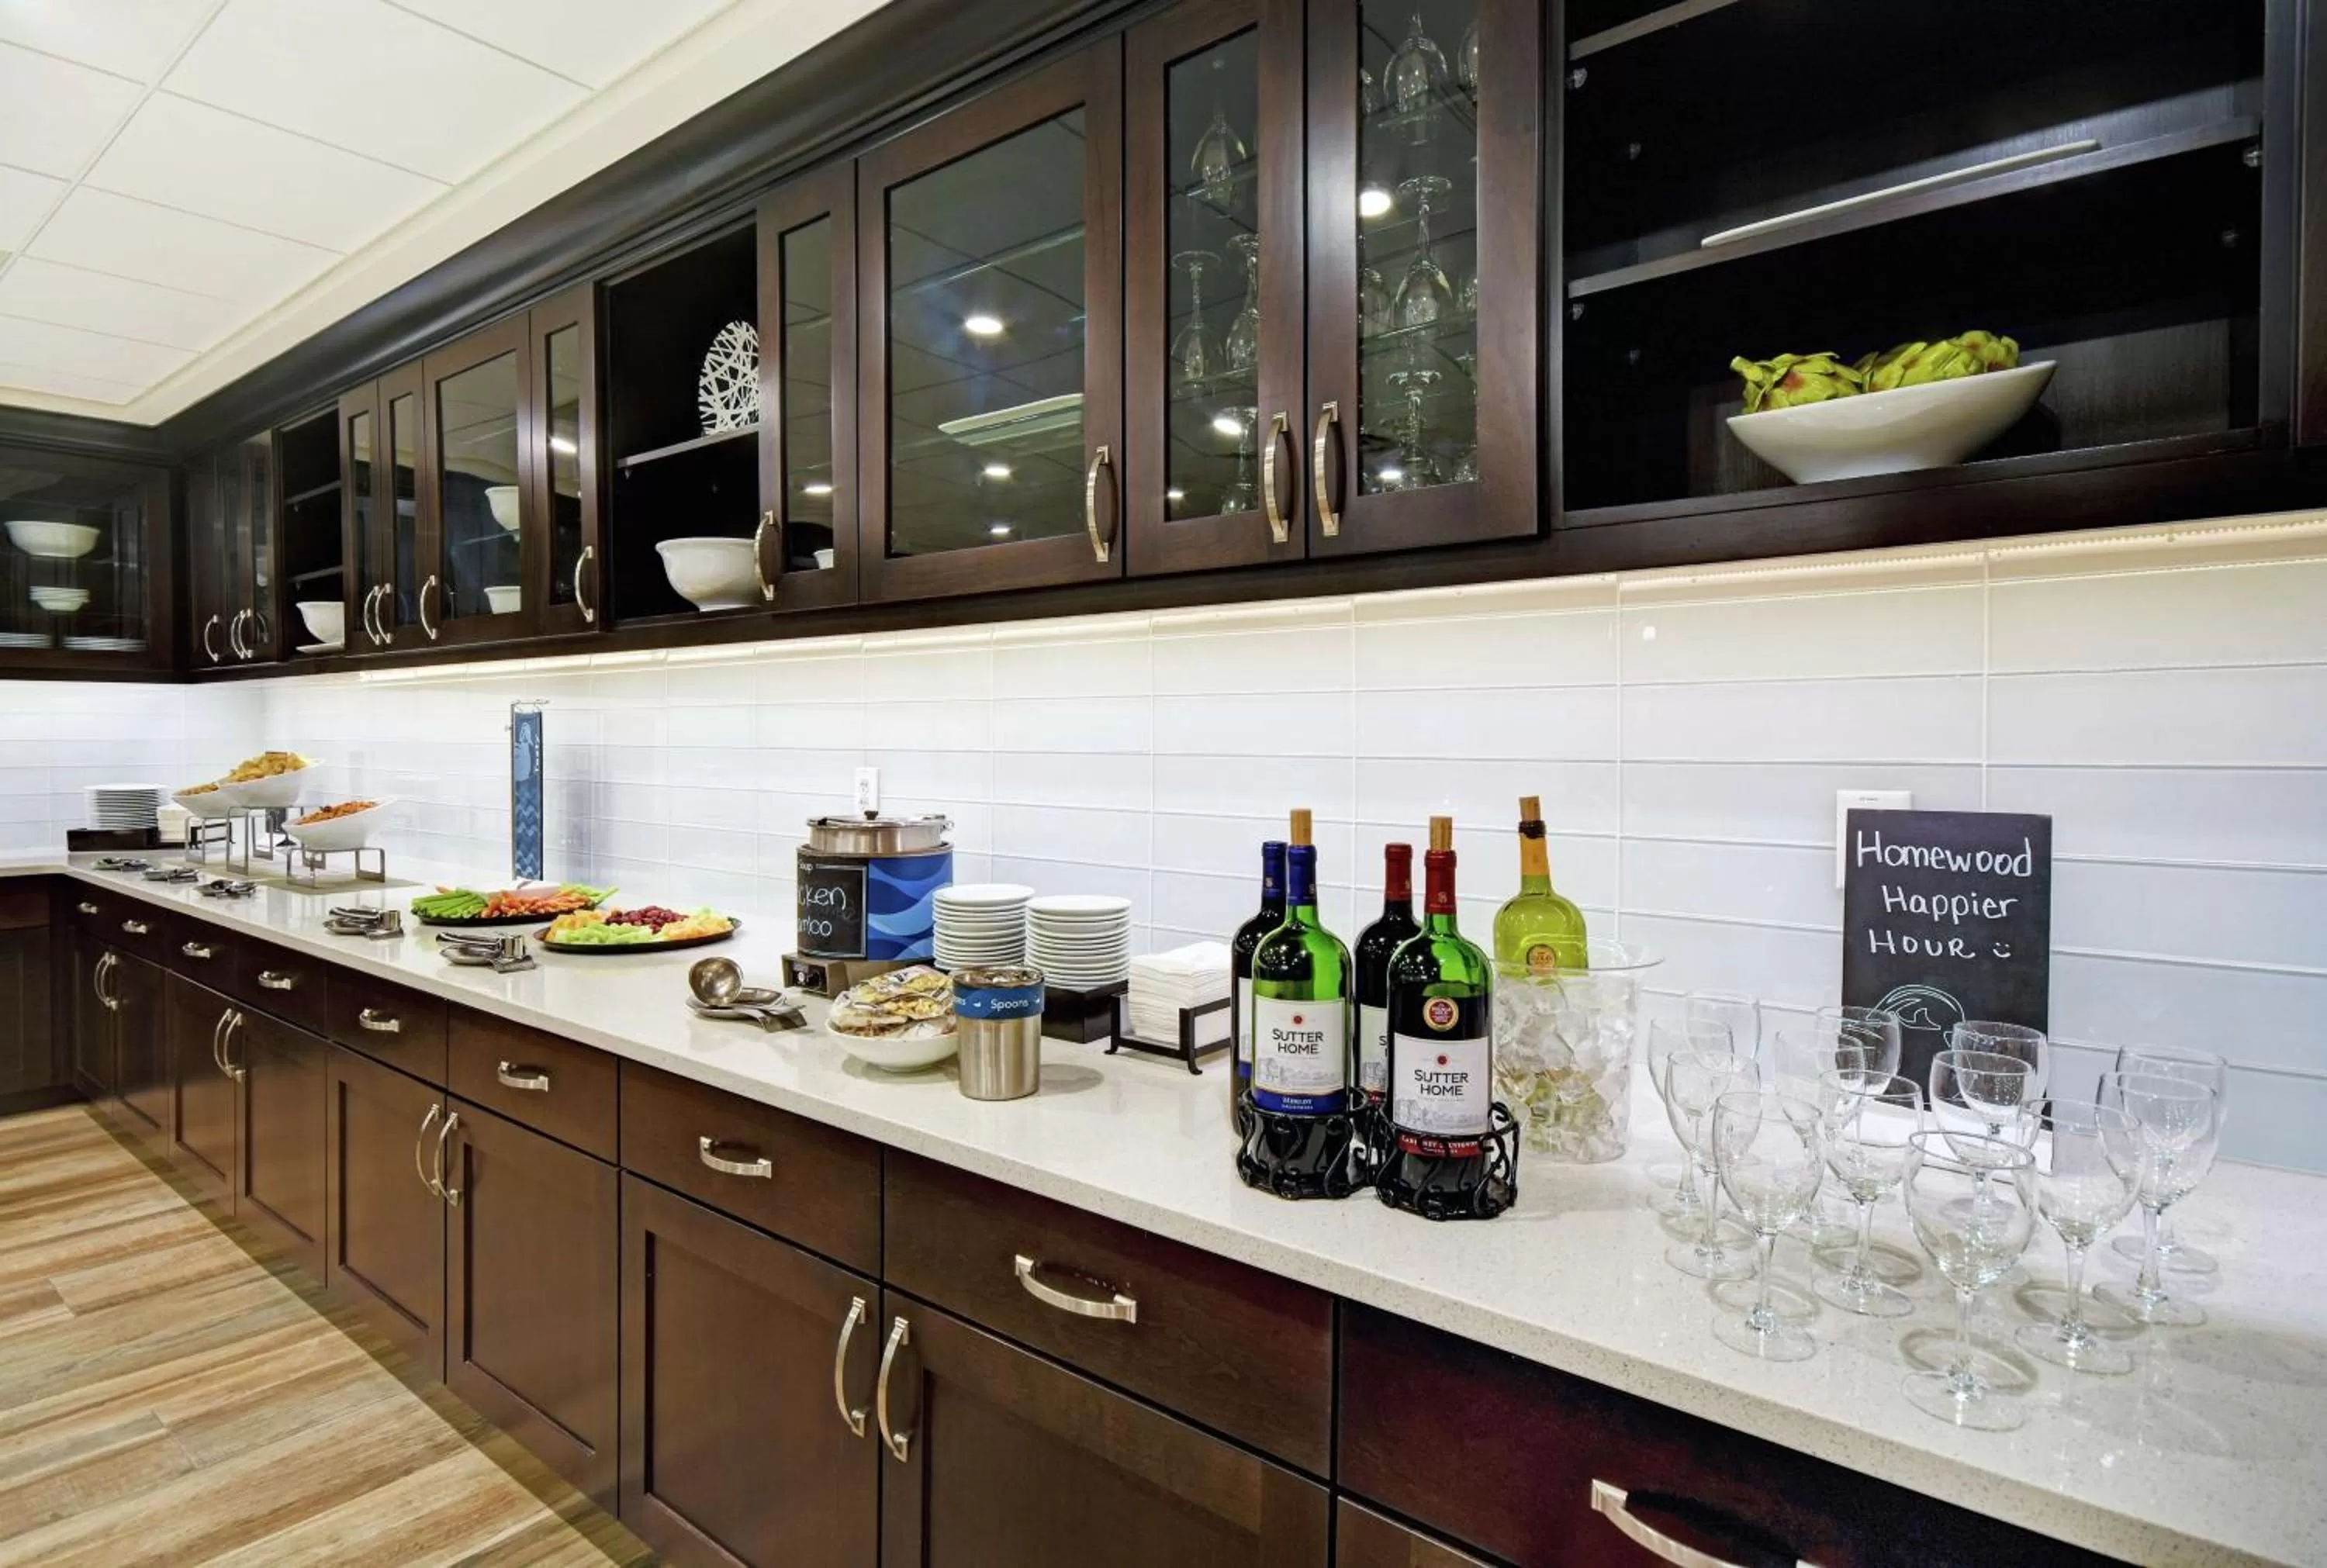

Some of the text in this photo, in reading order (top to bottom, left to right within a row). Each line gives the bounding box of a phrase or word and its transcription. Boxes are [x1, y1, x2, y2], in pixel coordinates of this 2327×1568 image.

[1856, 830, 2032, 877] Homewood
[1882, 885, 2019, 925] Happier
[991, 999, 1029, 1012] Spoons
[1272, 1027, 1324, 1043] SUTTER
[1277, 1042, 1320, 1054] HOME
[1414, 1069, 1469, 1084] SUTTER
[1420, 1083, 1464, 1097] HOME
